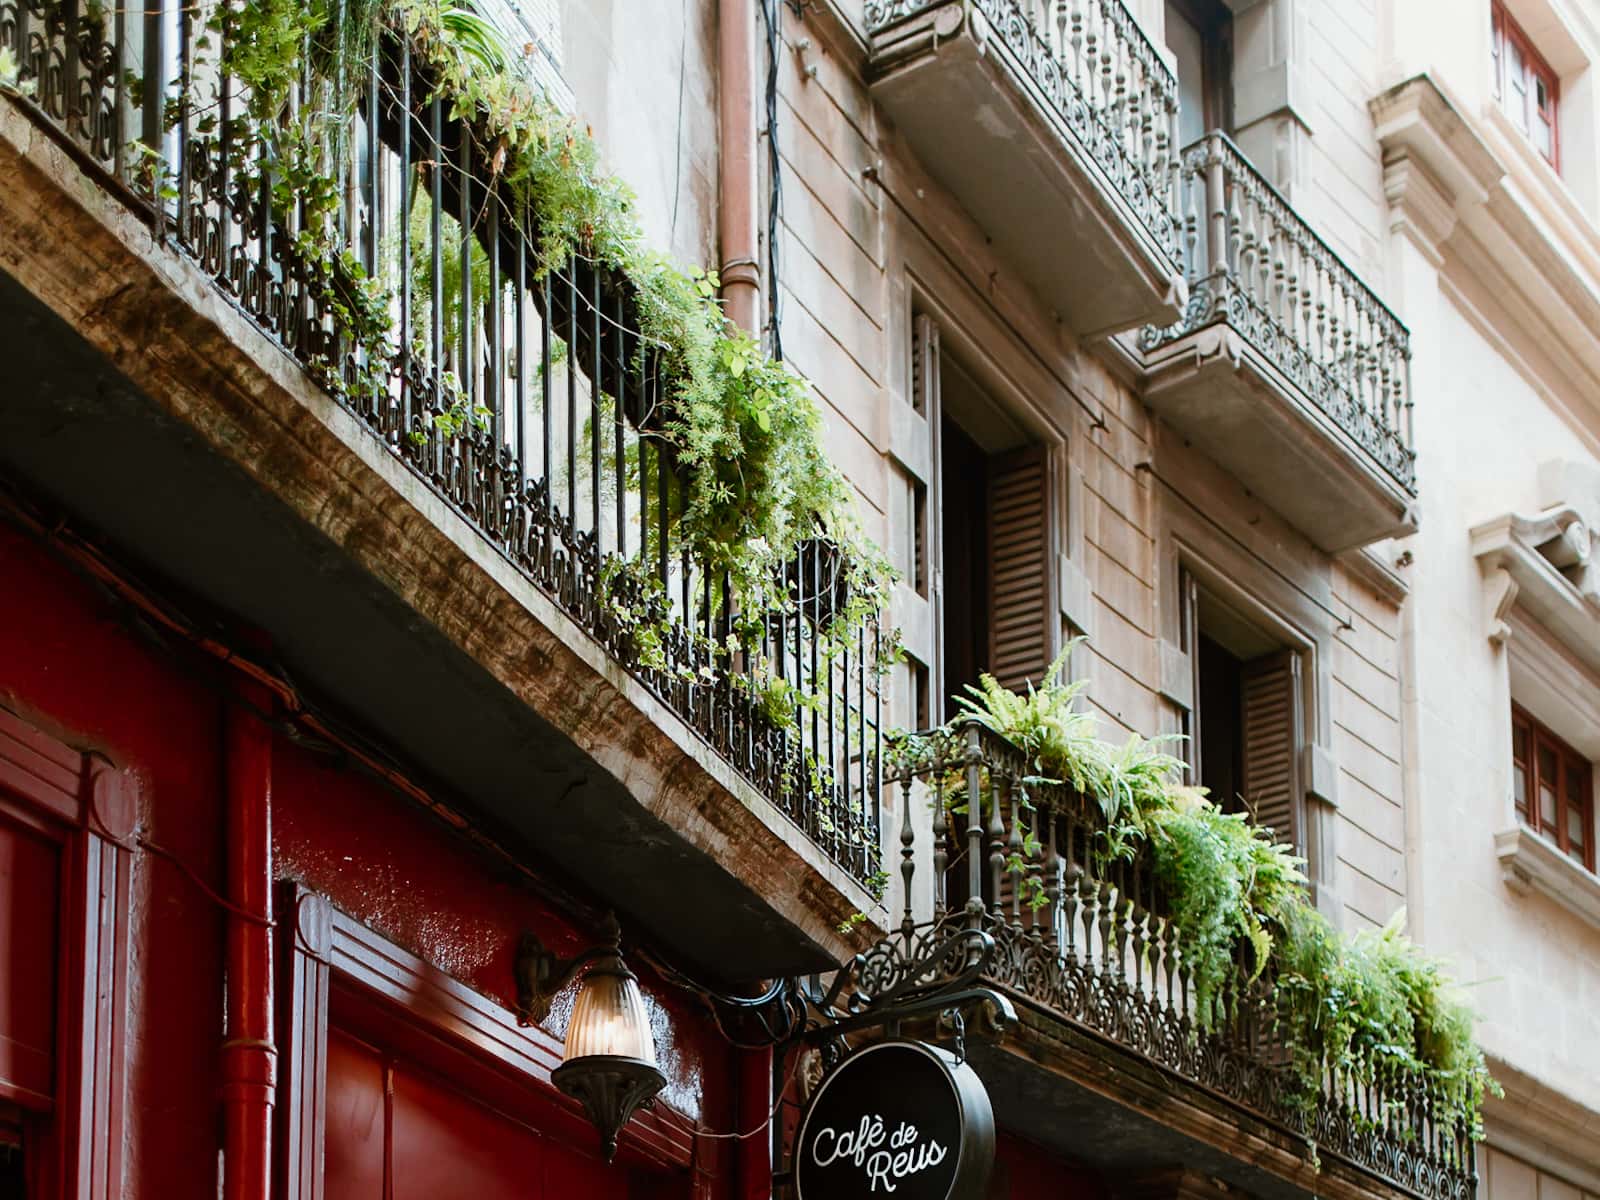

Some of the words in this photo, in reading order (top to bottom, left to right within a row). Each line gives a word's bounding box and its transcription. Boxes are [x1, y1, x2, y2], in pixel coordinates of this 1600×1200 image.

[812, 1114, 886, 1167] Cafè
[890, 1121, 919, 1149] de
[866, 1140, 948, 1192] Reus
